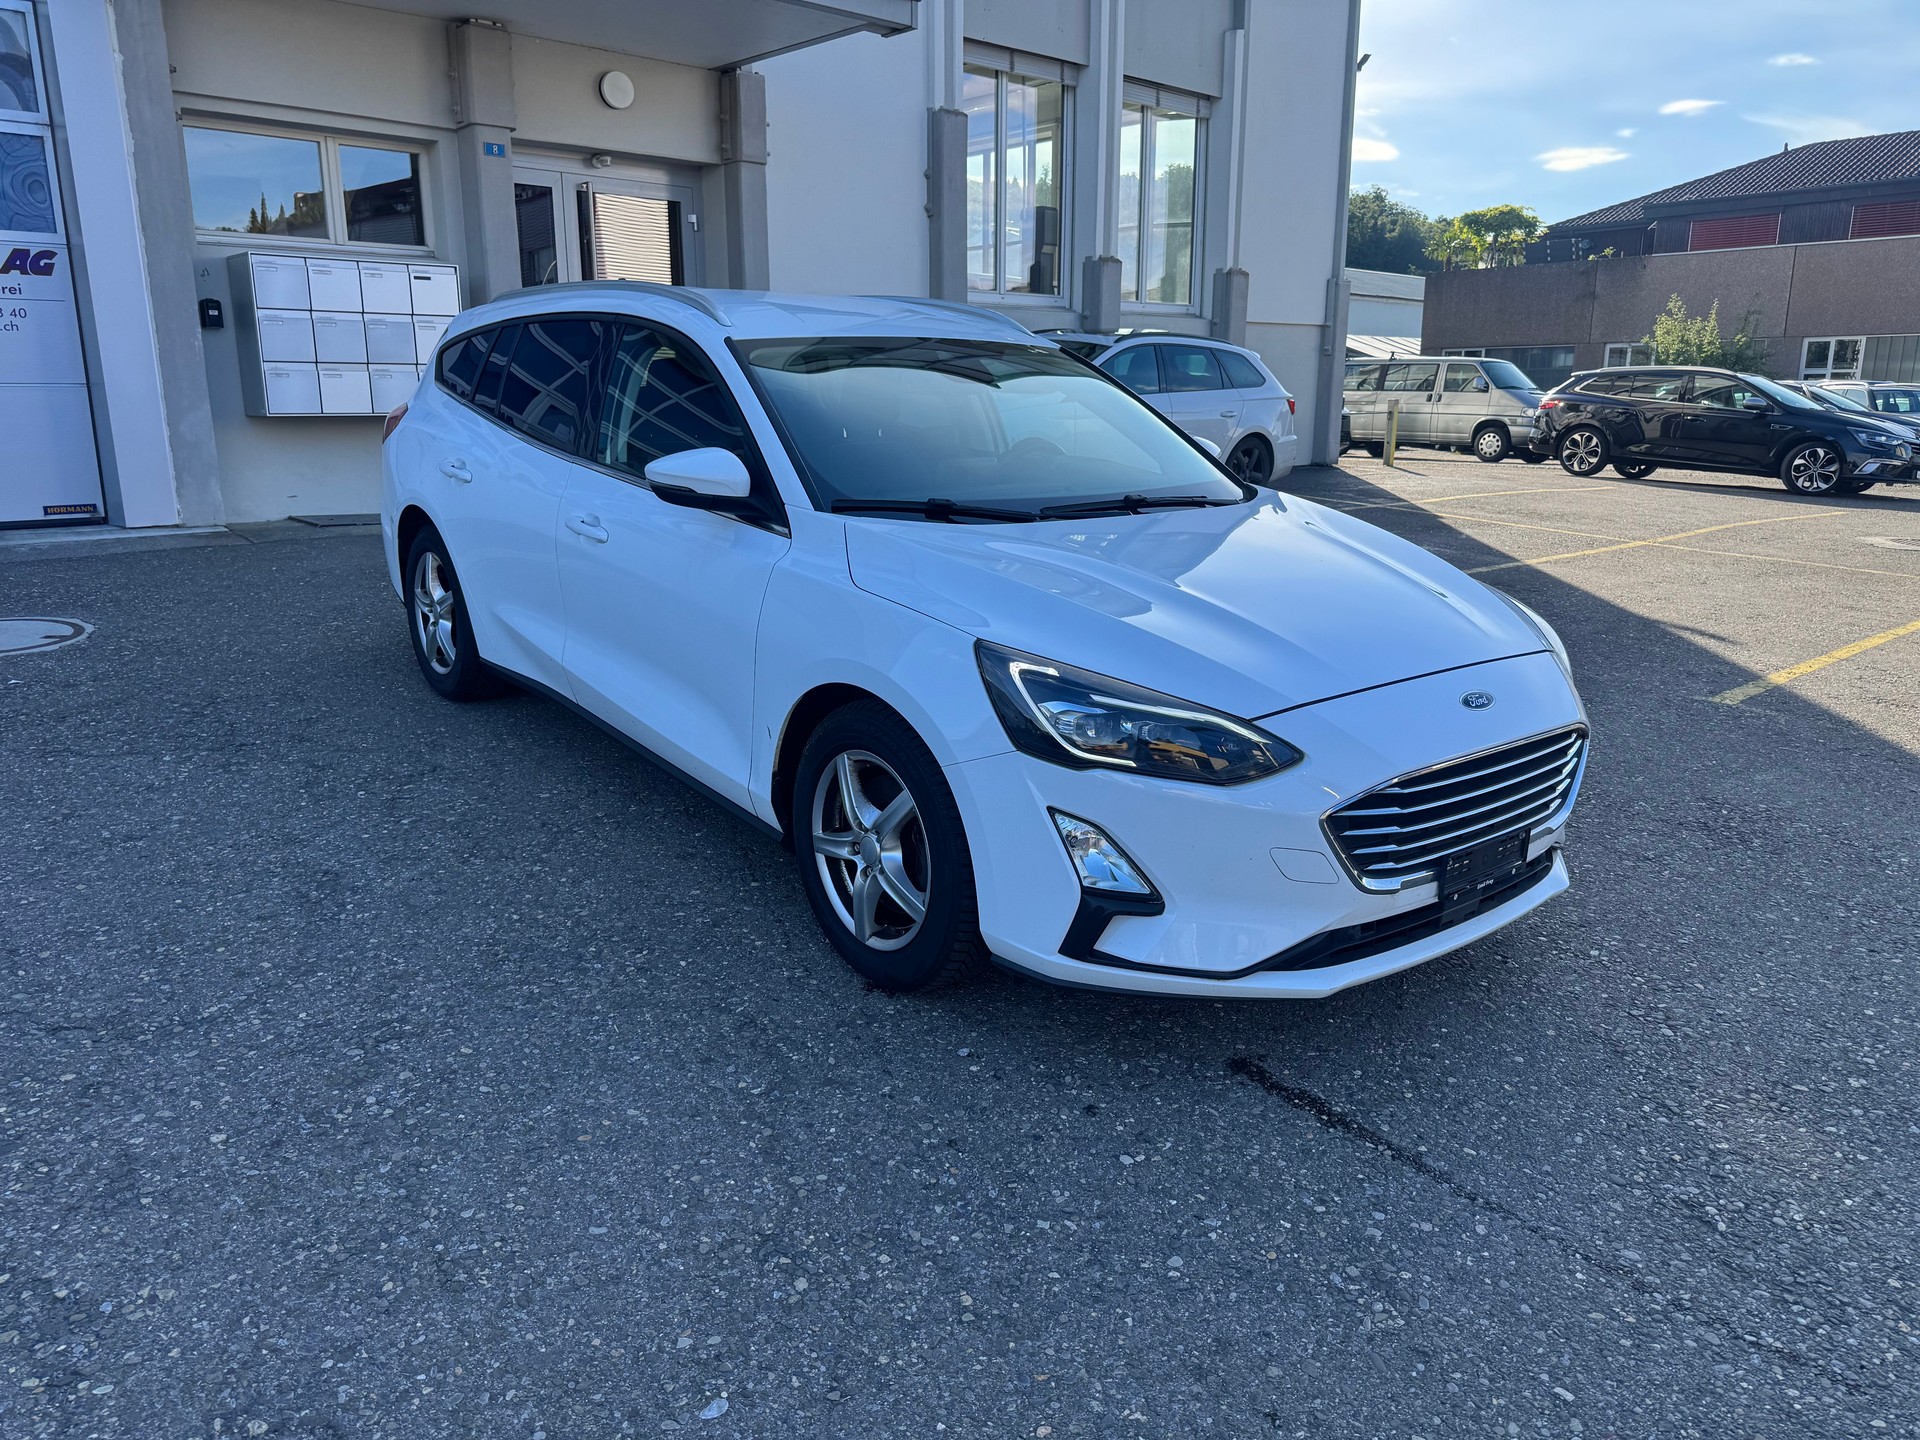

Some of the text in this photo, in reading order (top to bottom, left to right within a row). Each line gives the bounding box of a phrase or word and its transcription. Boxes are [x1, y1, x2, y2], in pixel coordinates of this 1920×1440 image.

[0, 248, 58, 277] AG
[0, 283, 22, 295] rei
[9, 308, 27, 319] 40
[1467, 694, 1489, 706] Ford
